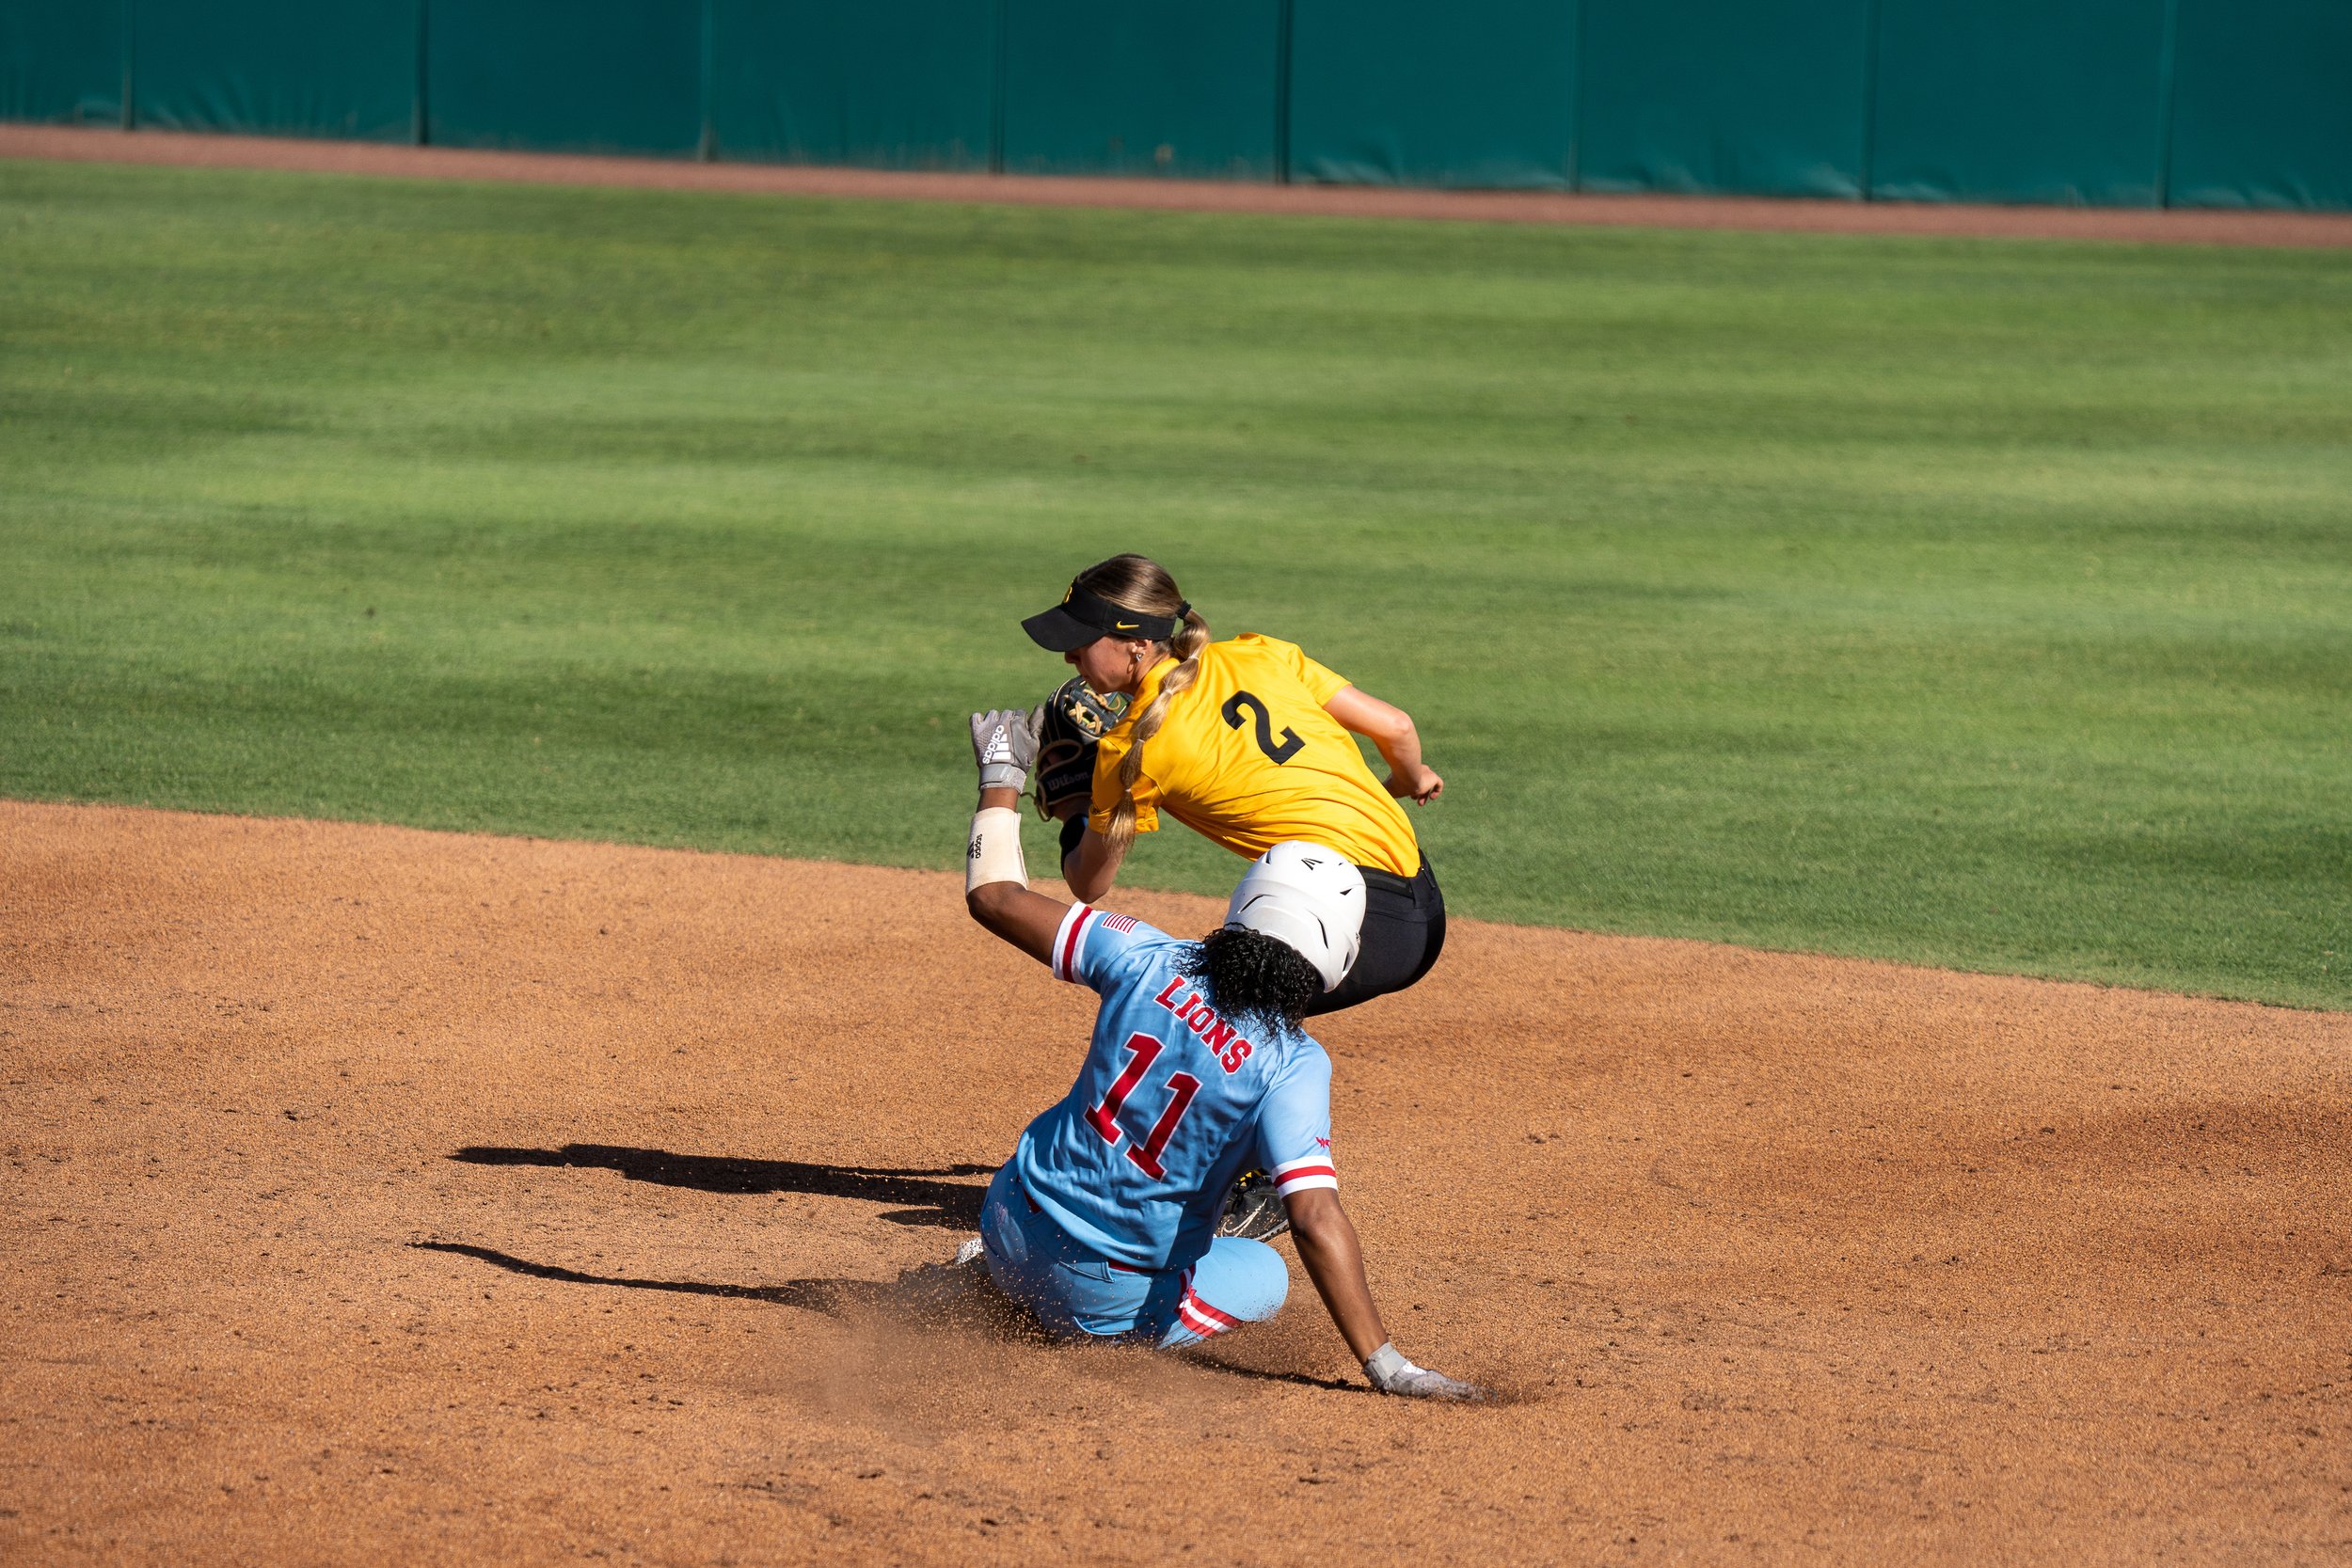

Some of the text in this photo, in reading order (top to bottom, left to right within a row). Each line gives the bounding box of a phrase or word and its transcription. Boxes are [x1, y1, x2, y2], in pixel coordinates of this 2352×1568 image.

[982, 724, 1005, 765] adidas
[1221, 690, 1306, 766] 2
[1046, 771, 1090, 791] Wilson
[1153, 974, 1254, 1075] LIONS
[1083, 1031, 1203, 1182] 11
